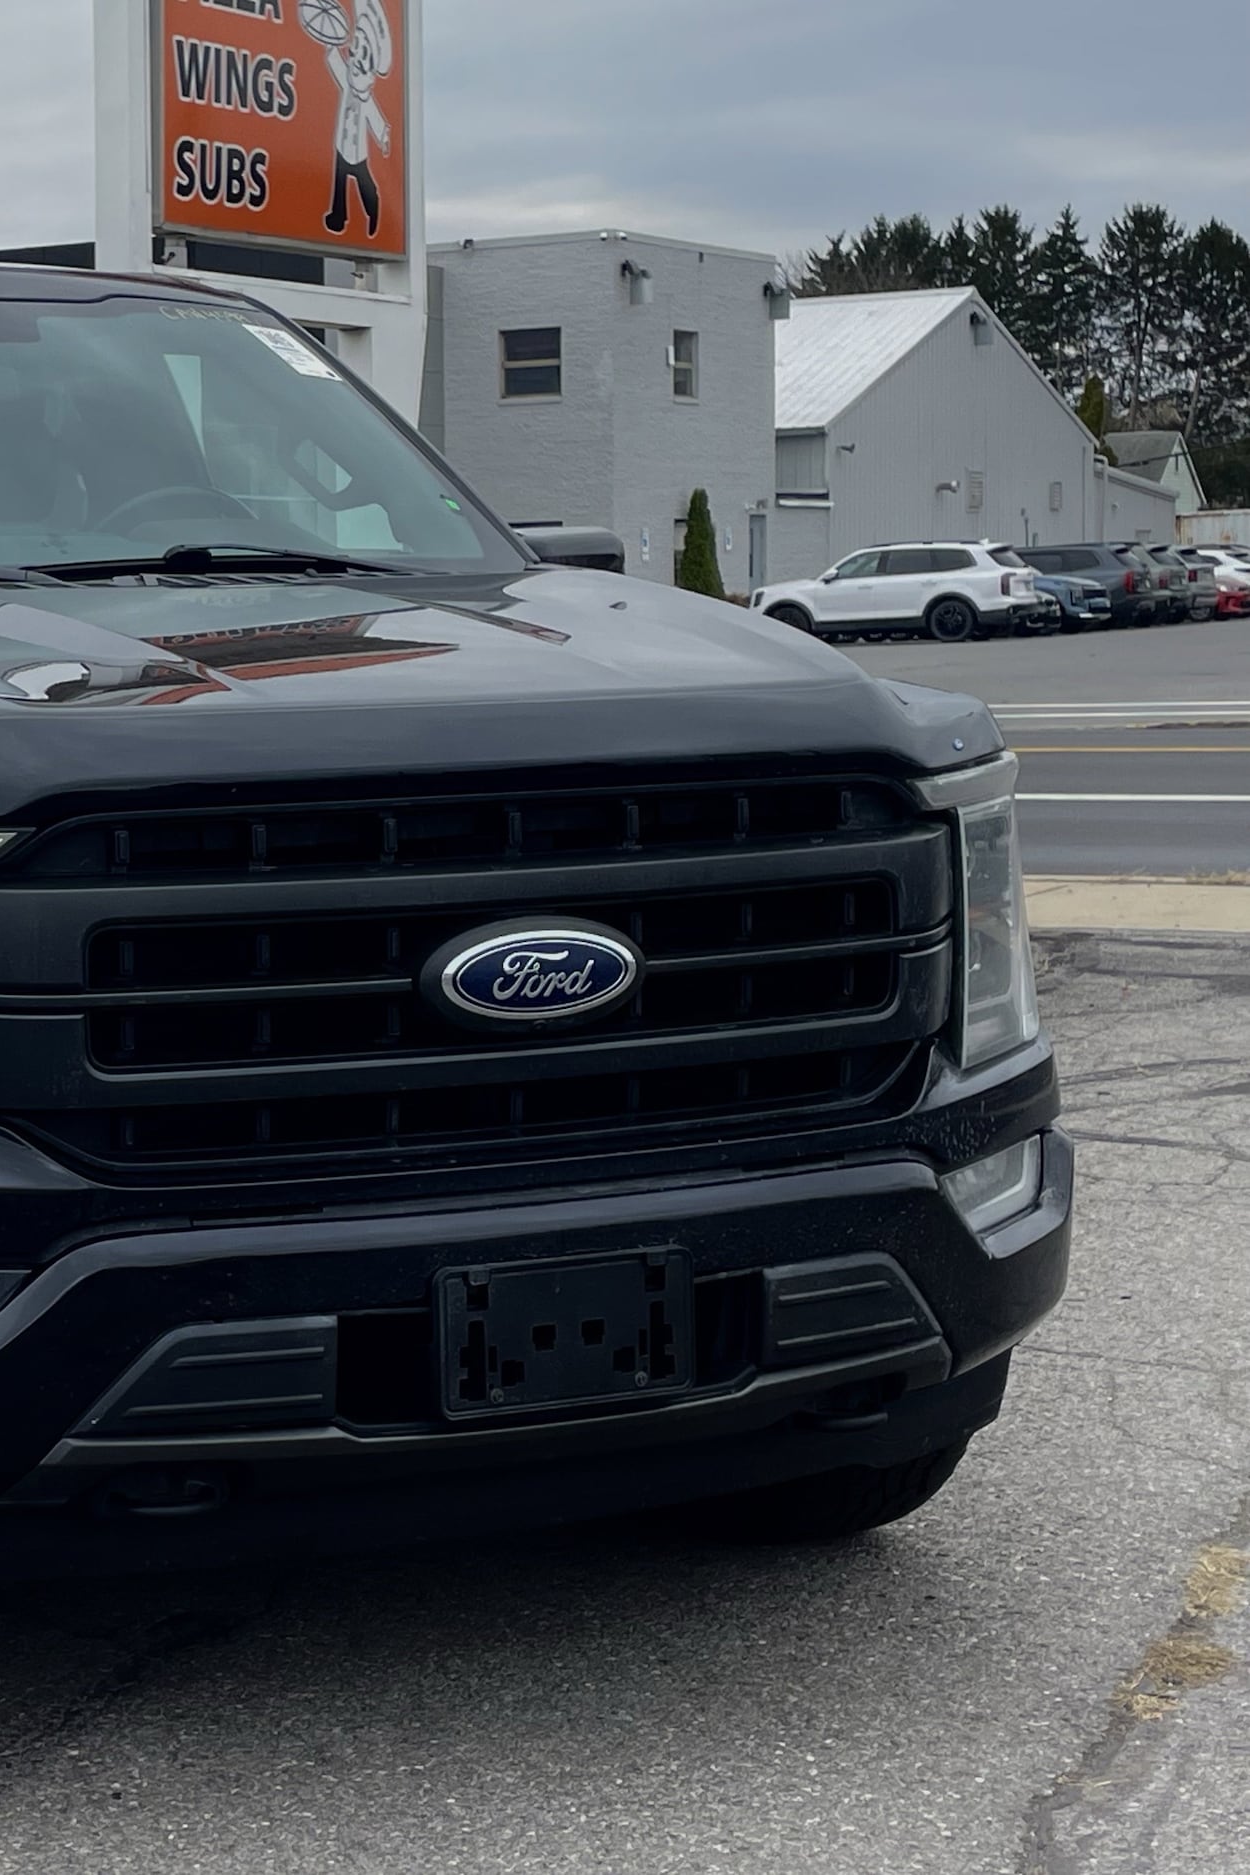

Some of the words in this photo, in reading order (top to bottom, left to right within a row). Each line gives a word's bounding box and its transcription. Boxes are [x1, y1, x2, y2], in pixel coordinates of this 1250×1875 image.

[174, 37, 295, 119] WINGS
[175, 137, 268, 210] SUBS
[492, 950, 594, 1001] Ford
